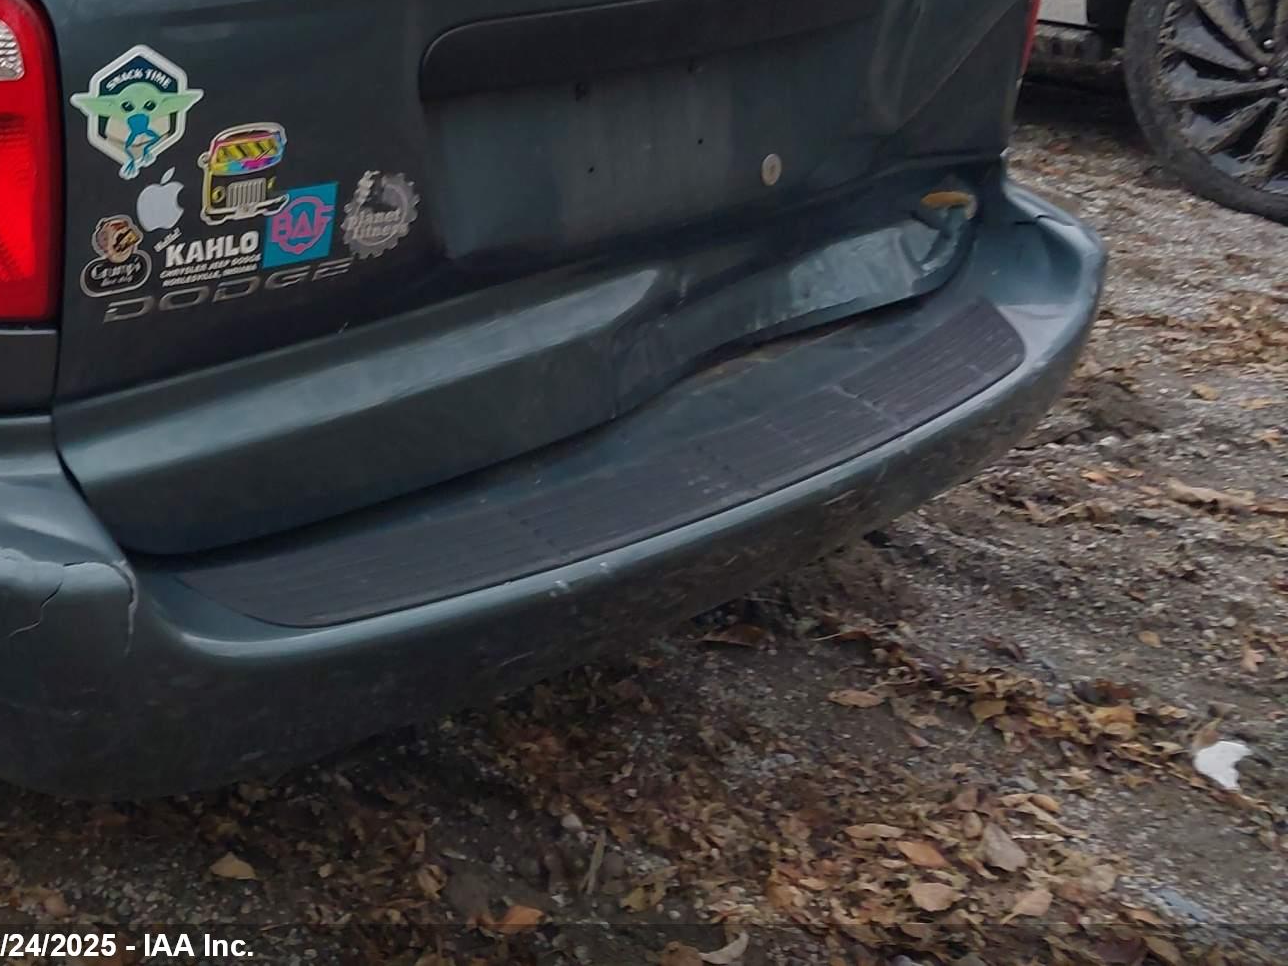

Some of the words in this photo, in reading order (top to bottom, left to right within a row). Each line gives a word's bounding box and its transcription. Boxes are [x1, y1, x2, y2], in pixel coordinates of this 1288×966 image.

[105, 68, 144, 92] SNACK
[144, 68, 172, 90] TIME
[165, 230, 260, 268] KAHLO
[103, 258, 353, 323] DODGE
